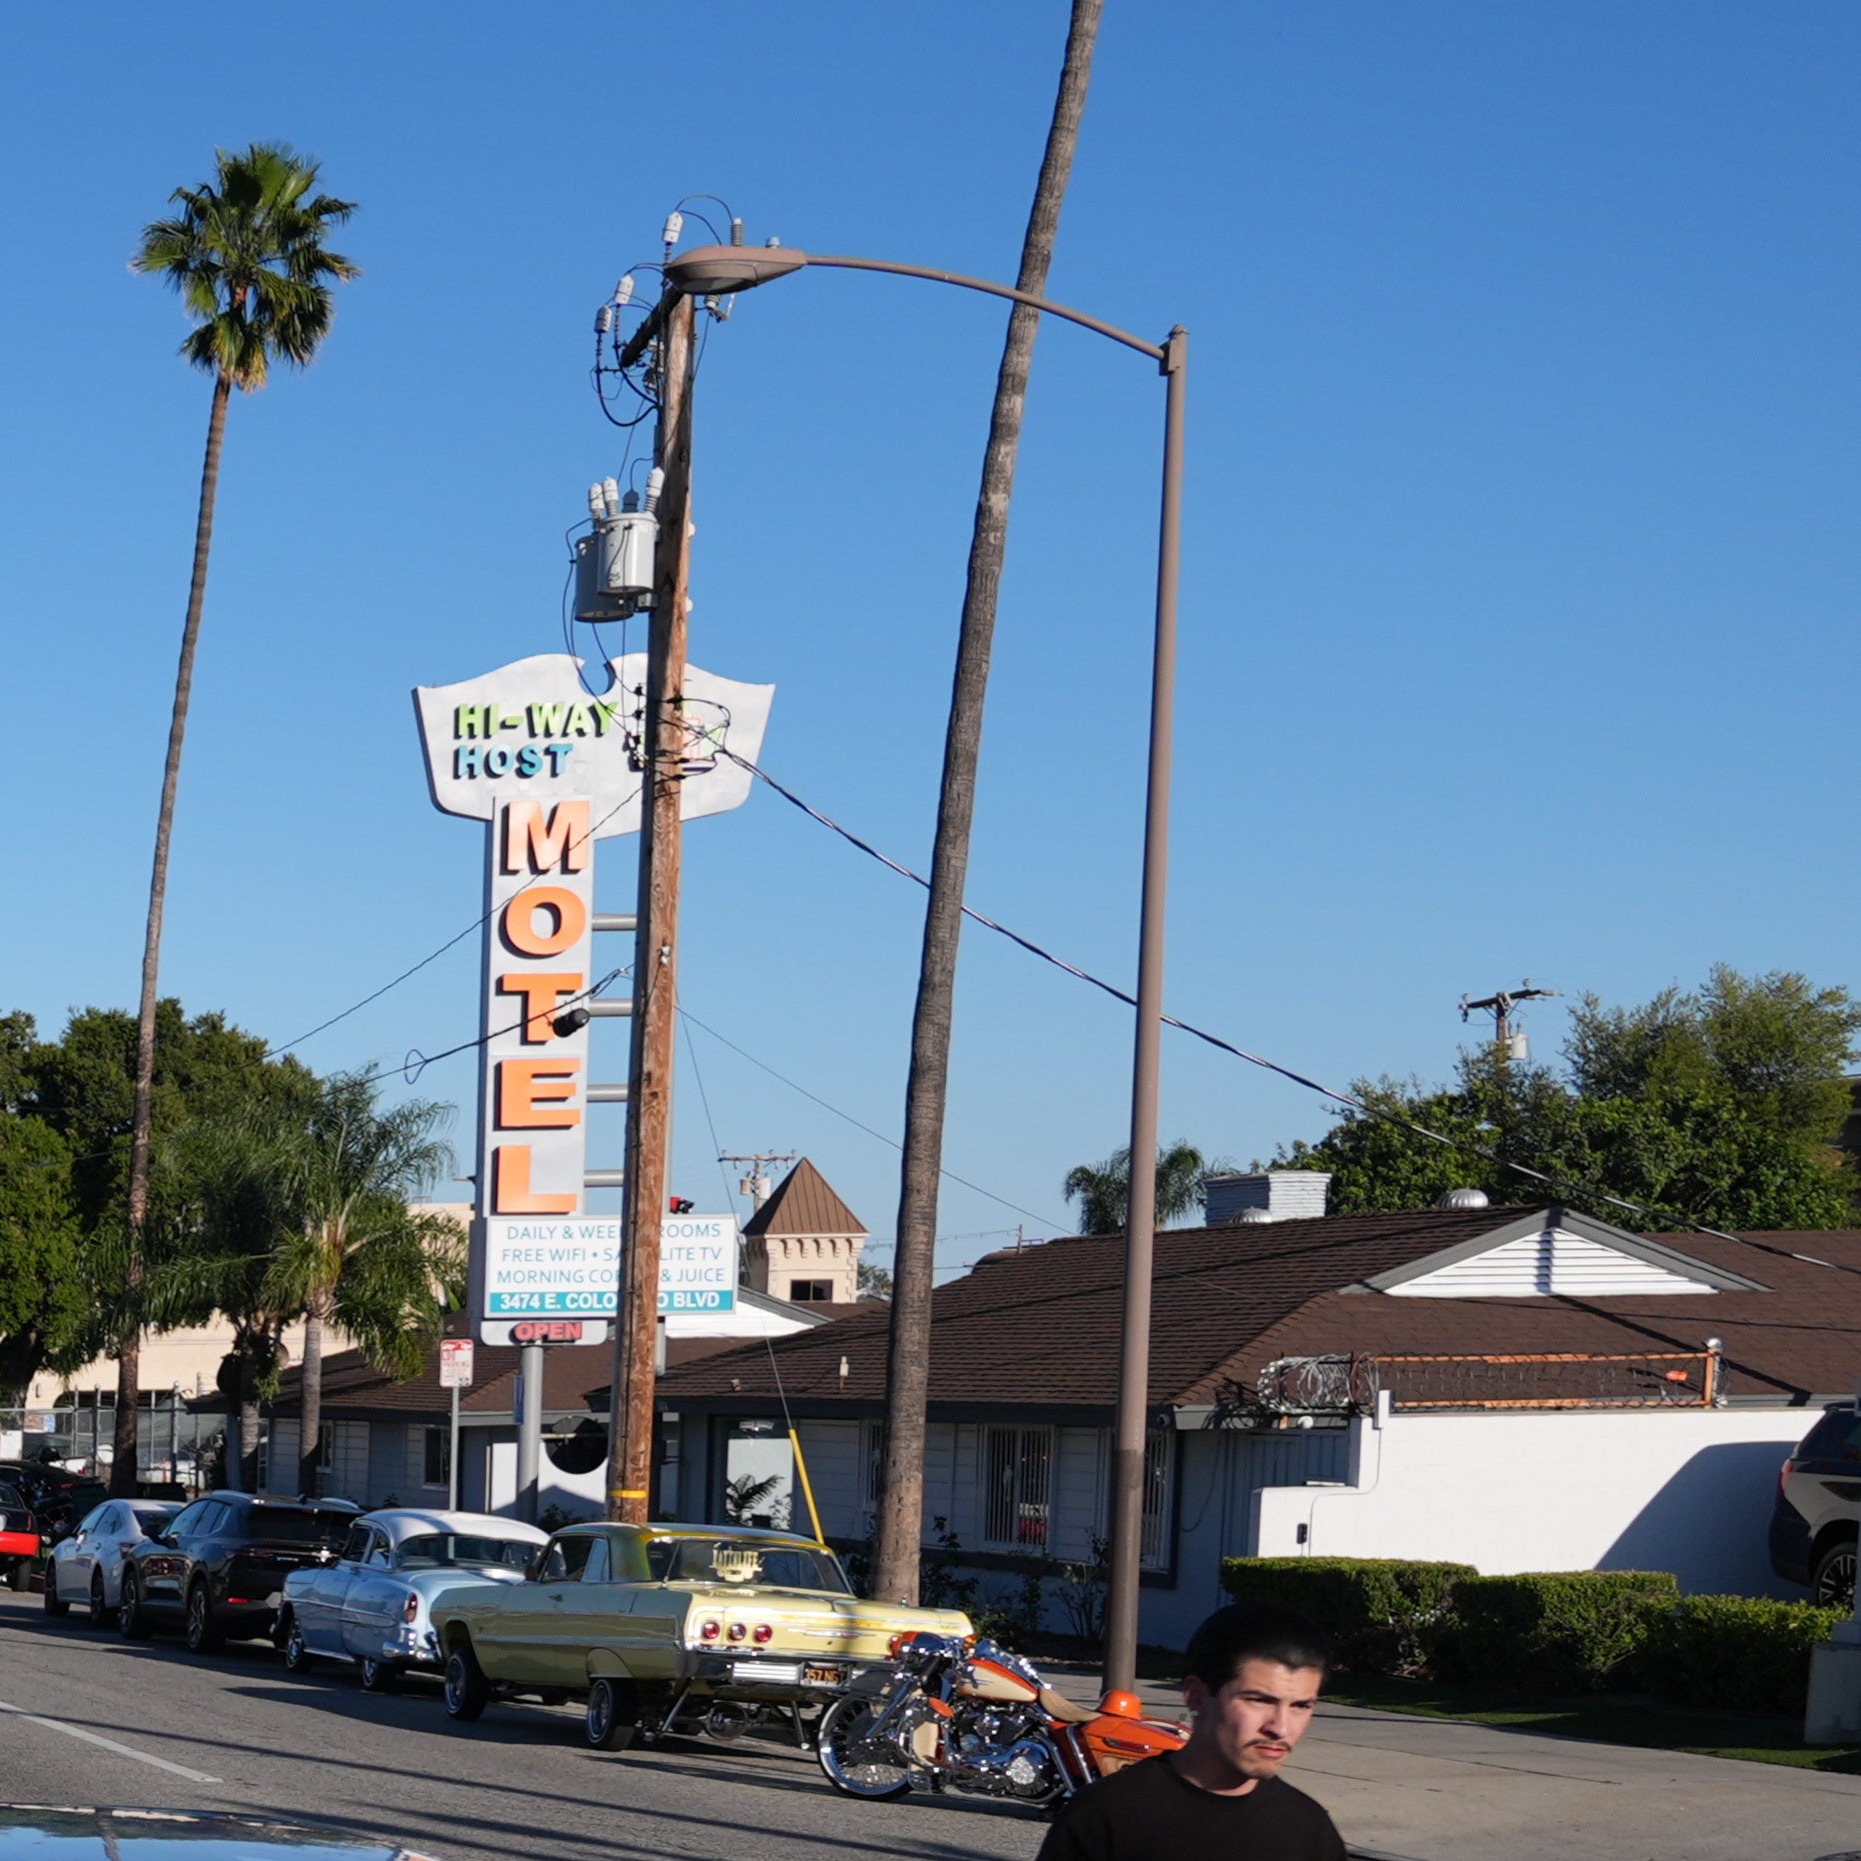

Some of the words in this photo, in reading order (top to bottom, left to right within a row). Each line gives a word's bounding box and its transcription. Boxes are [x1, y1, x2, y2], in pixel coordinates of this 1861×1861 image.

[454, 702, 619, 738] HI-WAY
[454, 744, 573, 779] HOST
[496, 800, 591, 1213] MOTEL
[507, 1226, 558, 1240] DAILY
[562, 1226, 574, 1239] &
[579, 1225, 620, 1239] WEE
[502, 1248, 544, 1262] FREE
[550, 1248, 586, 1262] WIFI
[702, 1246, 722, 1260] TV
[497, 1270, 584, 1284] MORNING
[676, 1268, 725, 1283] JUICE
[500, 1294, 541, 1310] 3474
[545, 1294, 561, 1309] E.
[674, 1291, 720, 1308] BLVD
[514, 1322, 582, 1340] OPEN
